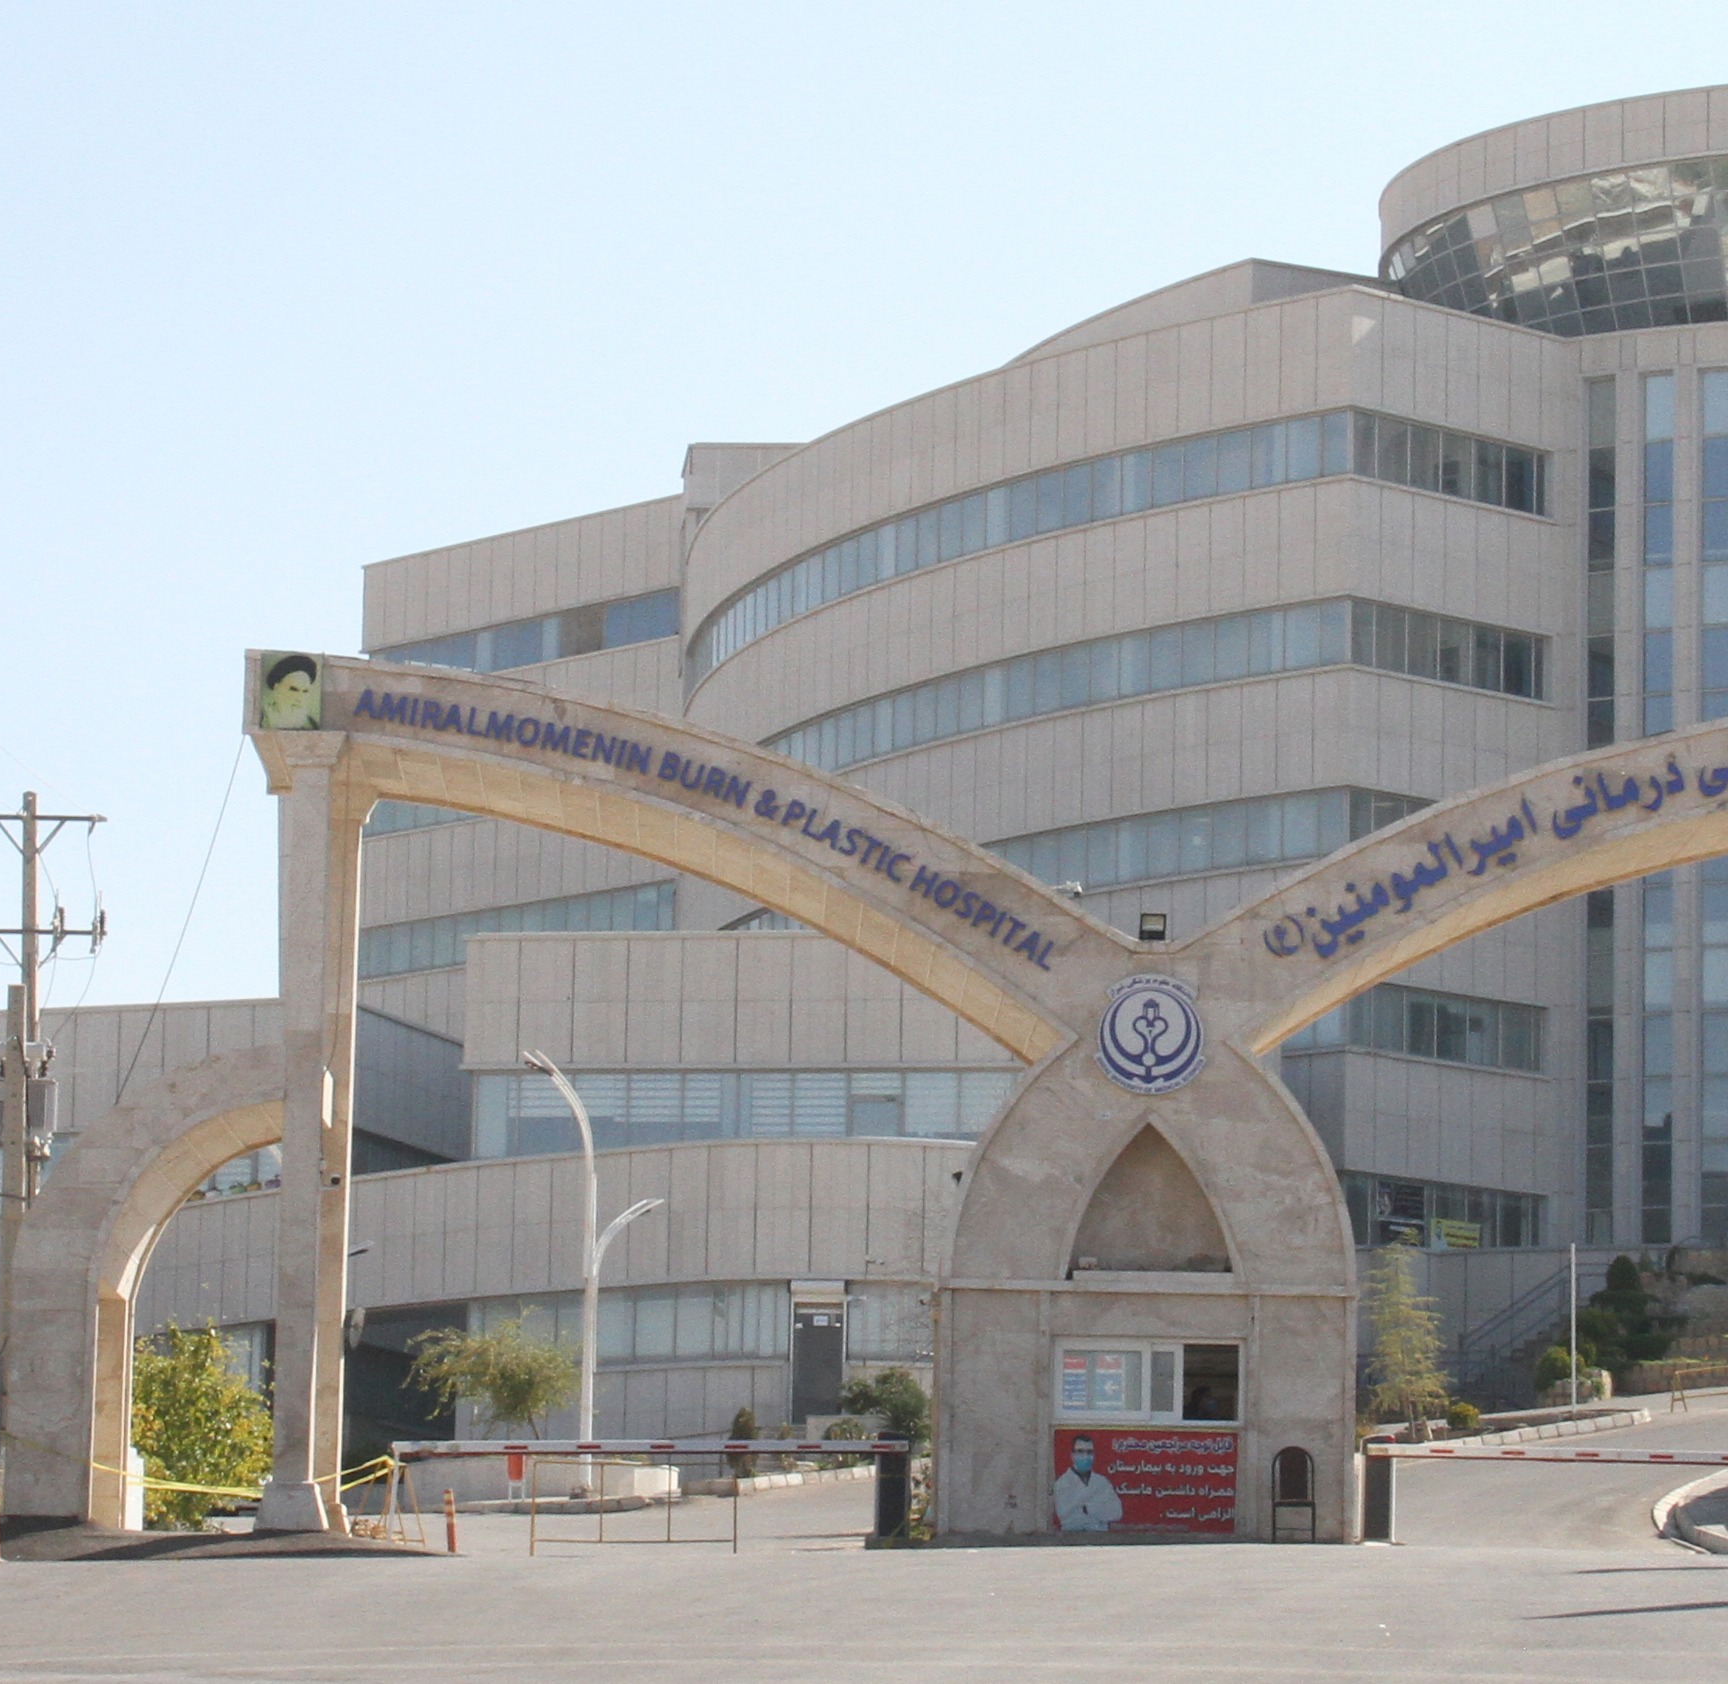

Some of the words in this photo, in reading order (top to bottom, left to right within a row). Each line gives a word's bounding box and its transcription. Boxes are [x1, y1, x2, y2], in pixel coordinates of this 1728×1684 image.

[1552, 755, 1686, 839] درمانی
[354, 688, 652, 776] AMIRALMOMENIN
[657, 751, 751, 807] BURN
[754, 789, 780, 821] &
[781, 800, 911, 884] PLASTIC
[910, 865, 1052, 972] HOSPITAL
[1107, 1459, 1162, 1475] بیمارستان
[1165, 1463, 1175, 1476] به
[1179, 1462, 1204, 1476] ورود
[1208, 1464, 1235, 1477] جهت
[1116, 1481, 1153, 1495] ماسک
[1199, 1484, 1235, 1499] همراه
